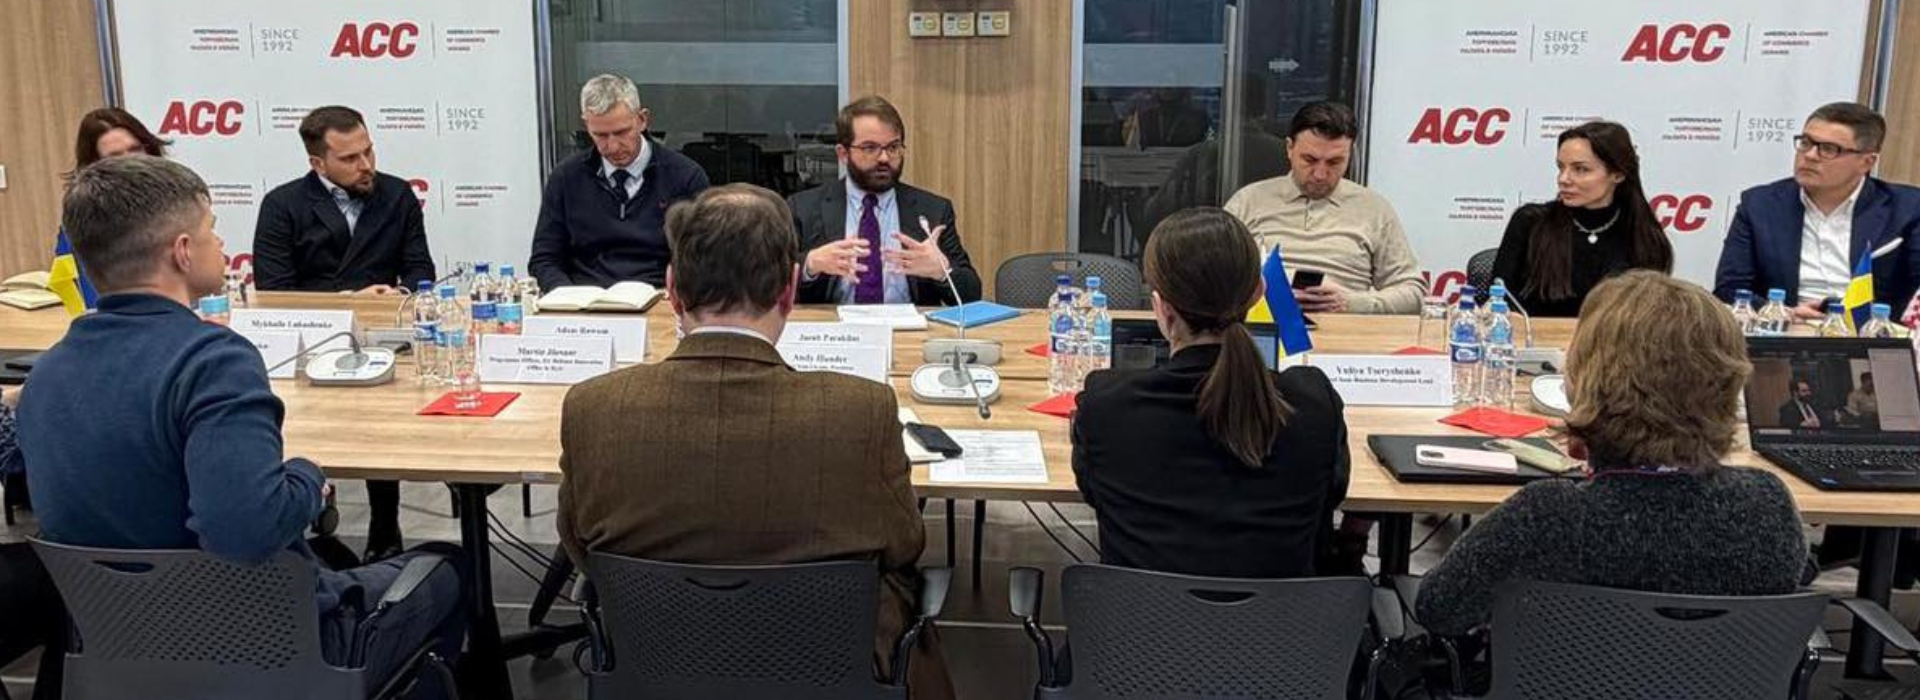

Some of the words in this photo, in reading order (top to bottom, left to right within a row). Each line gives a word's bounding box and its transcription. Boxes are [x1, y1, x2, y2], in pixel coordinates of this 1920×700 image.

[261, 28, 300, 40] SINCE
[330, 22, 419, 58] ACC
[1543, 30, 1589, 42] SINCE
[262, 40, 294, 52] 1992
[1621, 23, 1731, 62] ACC
[1544, 43, 1580, 55] 1992
[158, 100, 244, 135] ACC
[446, 107, 486, 119] SINCE
[448, 119, 479, 131] 1992
[1407, 107, 1511, 145] ACC
[1747, 117, 1796, 129] SINCE
[1747, 130, 1785, 142] 1992
